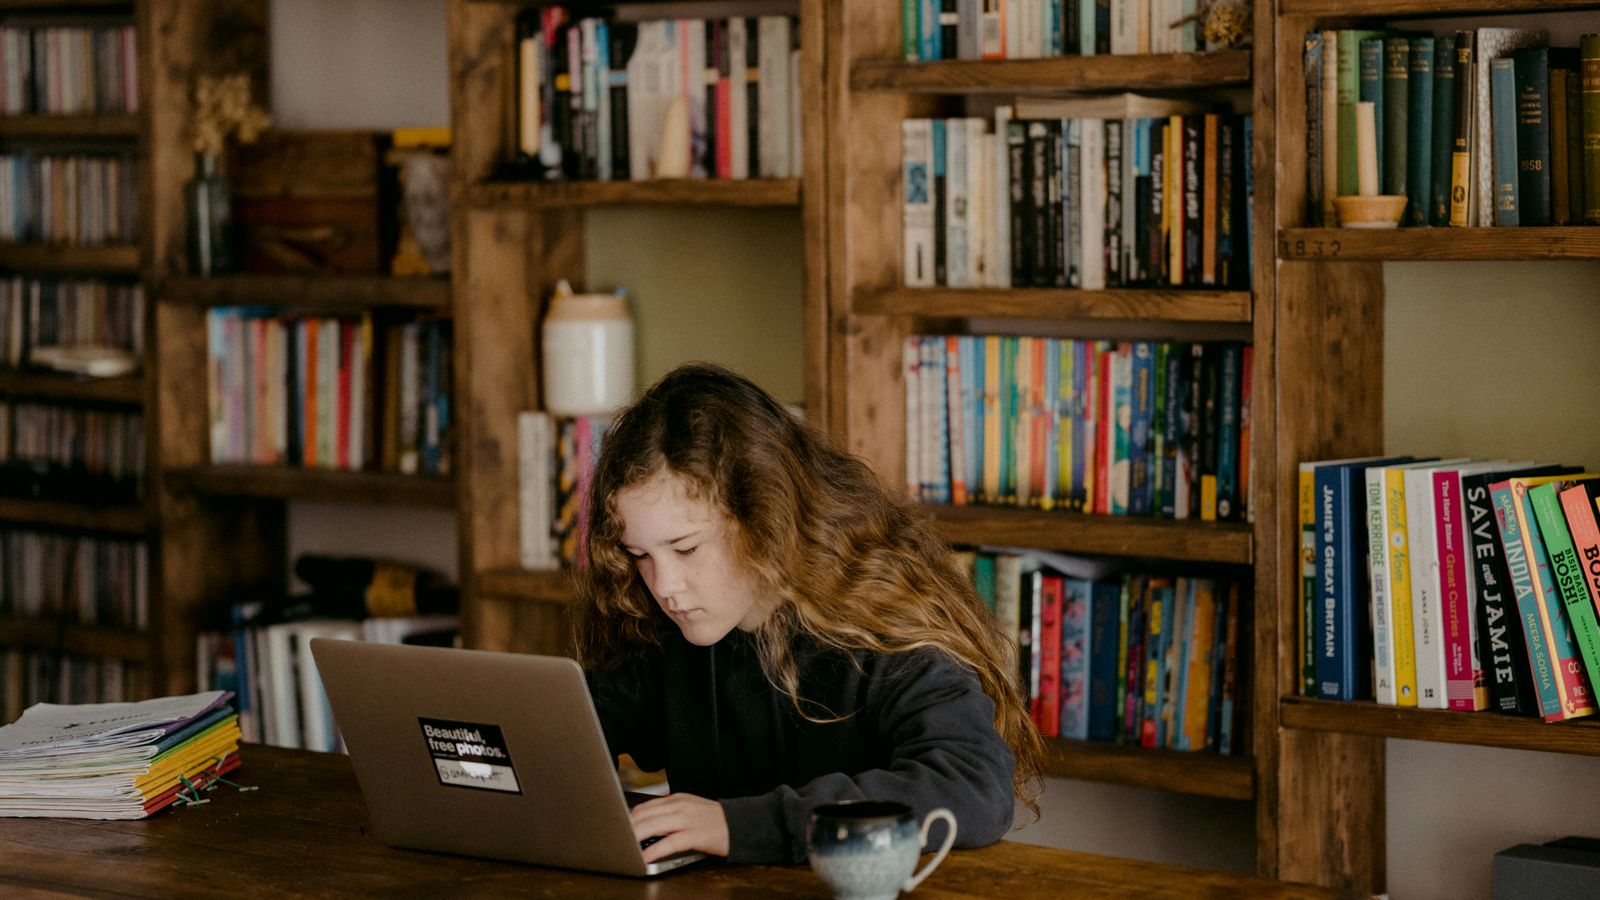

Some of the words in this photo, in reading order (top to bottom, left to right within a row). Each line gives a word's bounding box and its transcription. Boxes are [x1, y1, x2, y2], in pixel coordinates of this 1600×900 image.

[1521, 160, 1542, 171] 1958
[1369, 482, 1381, 507] TOM
[1442, 480, 1450, 497] The
[1443, 498, 1451, 522] Hairy
[1500, 494, 1515, 522] MADE
[1371, 509, 1384, 567] KERRIDGE
[1467, 487, 1495, 559] SAVE
[1325, 545, 1335, 595] GREAT
[1446, 553, 1456, 588] Great
[1482, 563, 1497, 586] with
[1505, 540, 1532, 600] INDIA
[1552, 551, 1579, 605] BOSH!
[1565, 548, 1577, 572] BISH
[1573, 574, 1587, 601] BASH
[1325, 598, 1335, 657] BRITAIN
[1422, 618, 1430, 645] JONES
[1448, 590, 1459, 638] Curries
[1483, 590, 1513, 683] JAMIE
[1527, 613, 1541, 650] MEERA
[1536, 651, 1550, 690] SODHA
[429, 738, 455, 752] free
[456, 742, 506, 758] photos.
